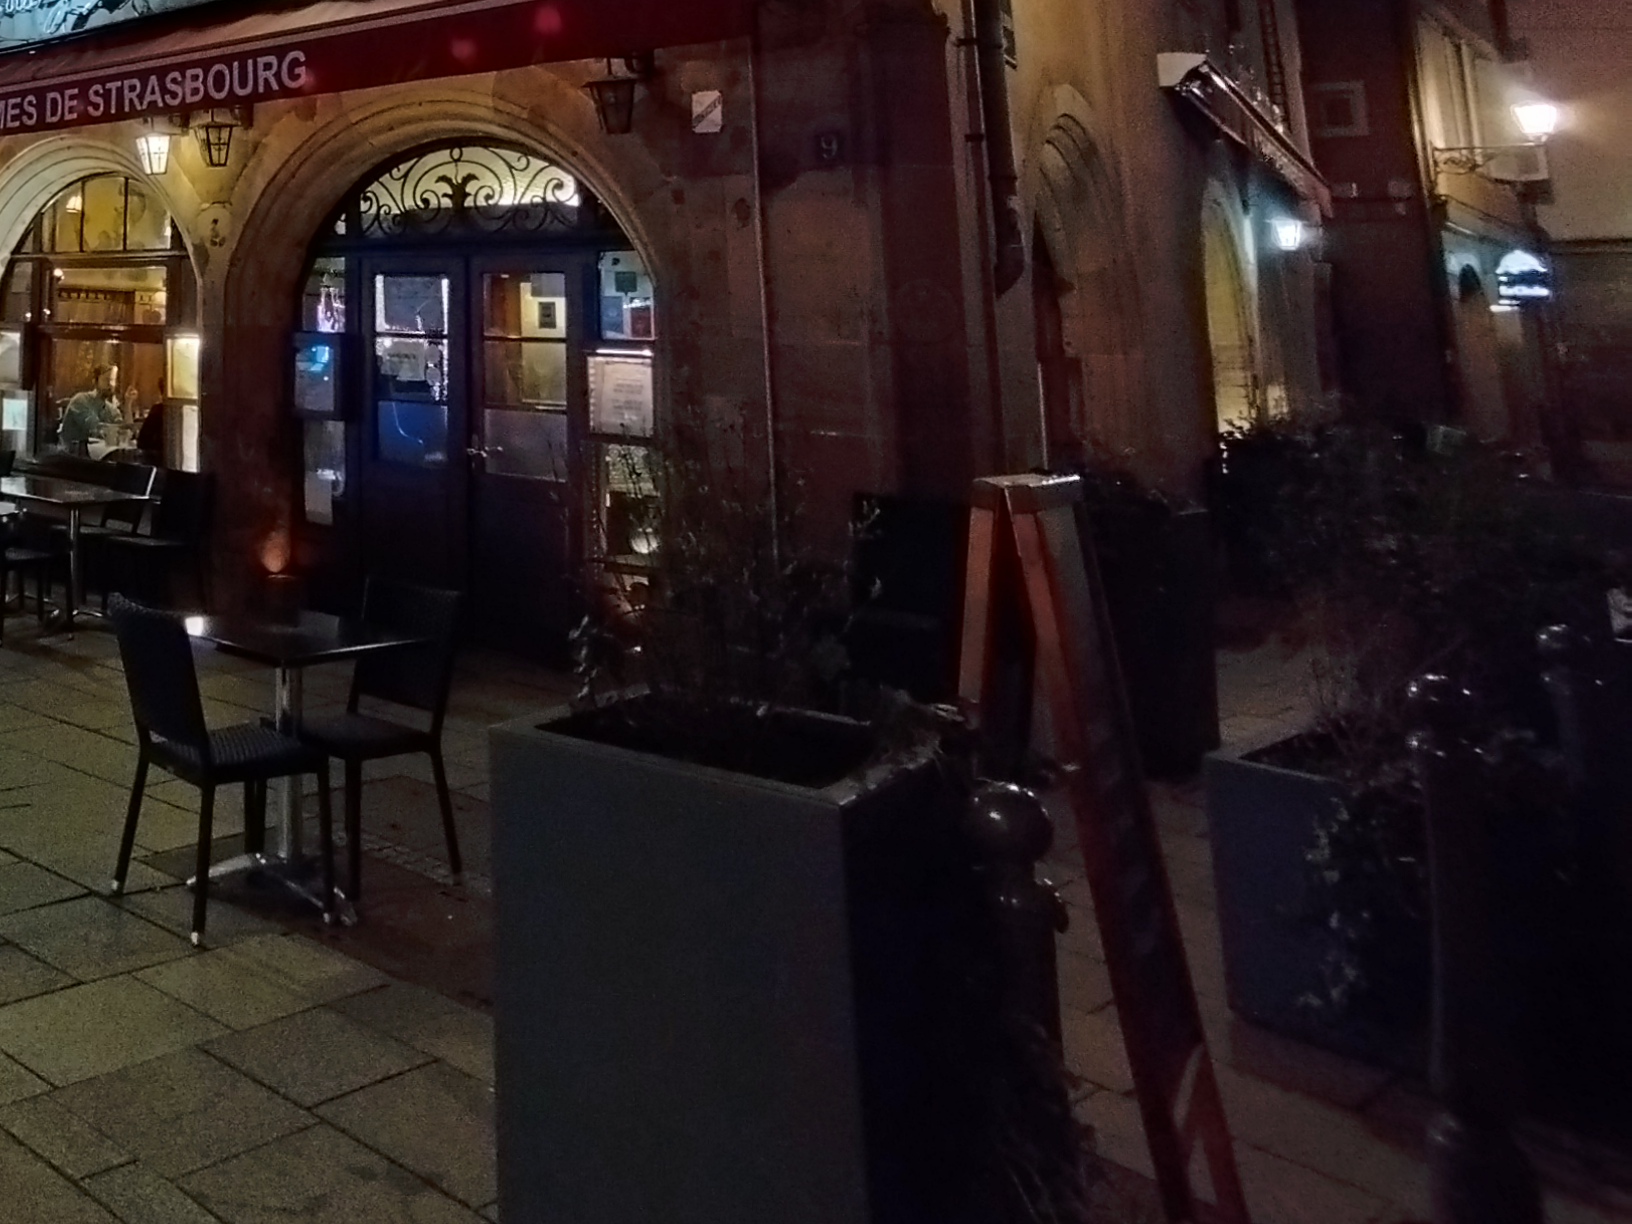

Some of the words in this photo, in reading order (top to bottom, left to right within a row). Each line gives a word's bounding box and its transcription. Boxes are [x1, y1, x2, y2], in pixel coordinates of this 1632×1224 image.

[45, 87, 80, 124] DE
[86, 50, 307, 118] STRASBOURG
[820, 133, 839, 160] 9
